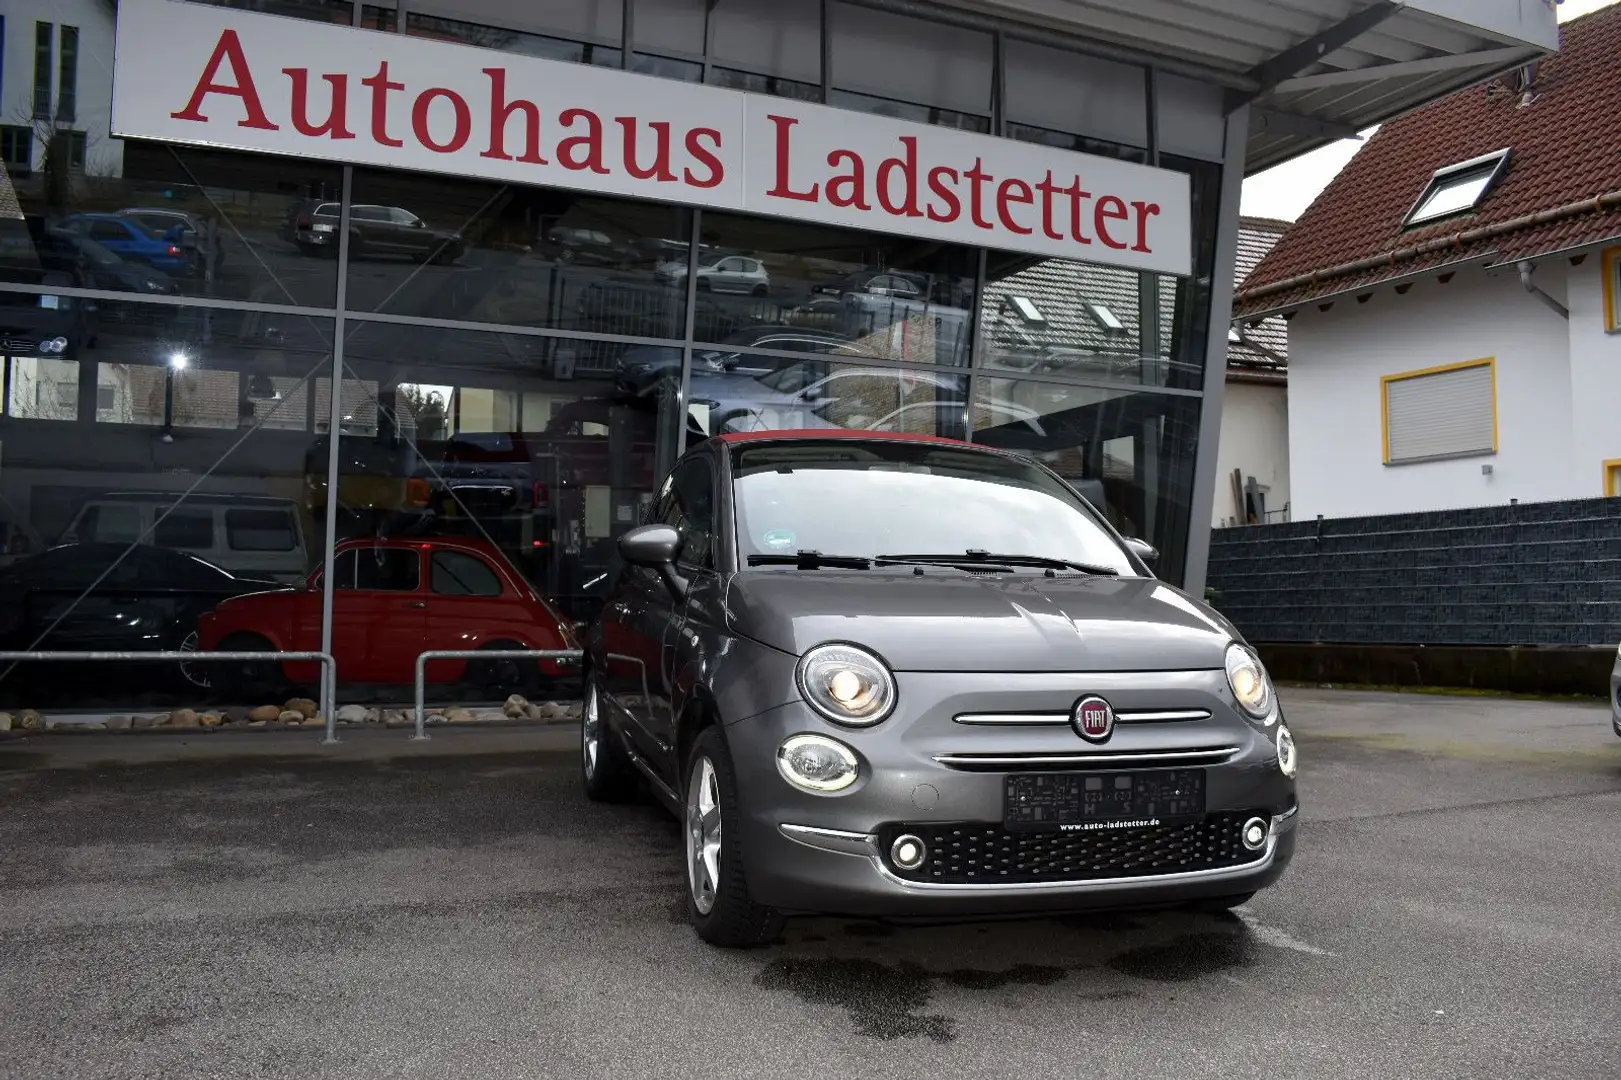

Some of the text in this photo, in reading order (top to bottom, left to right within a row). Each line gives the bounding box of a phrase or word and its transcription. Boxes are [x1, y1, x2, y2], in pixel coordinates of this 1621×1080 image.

[172, 30, 1160, 253] Autohaus Ladstetter
[1084, 710, 1106, 728] FIAT
[1060, 819, 1160, 830] www.auto-ladstetter.de
